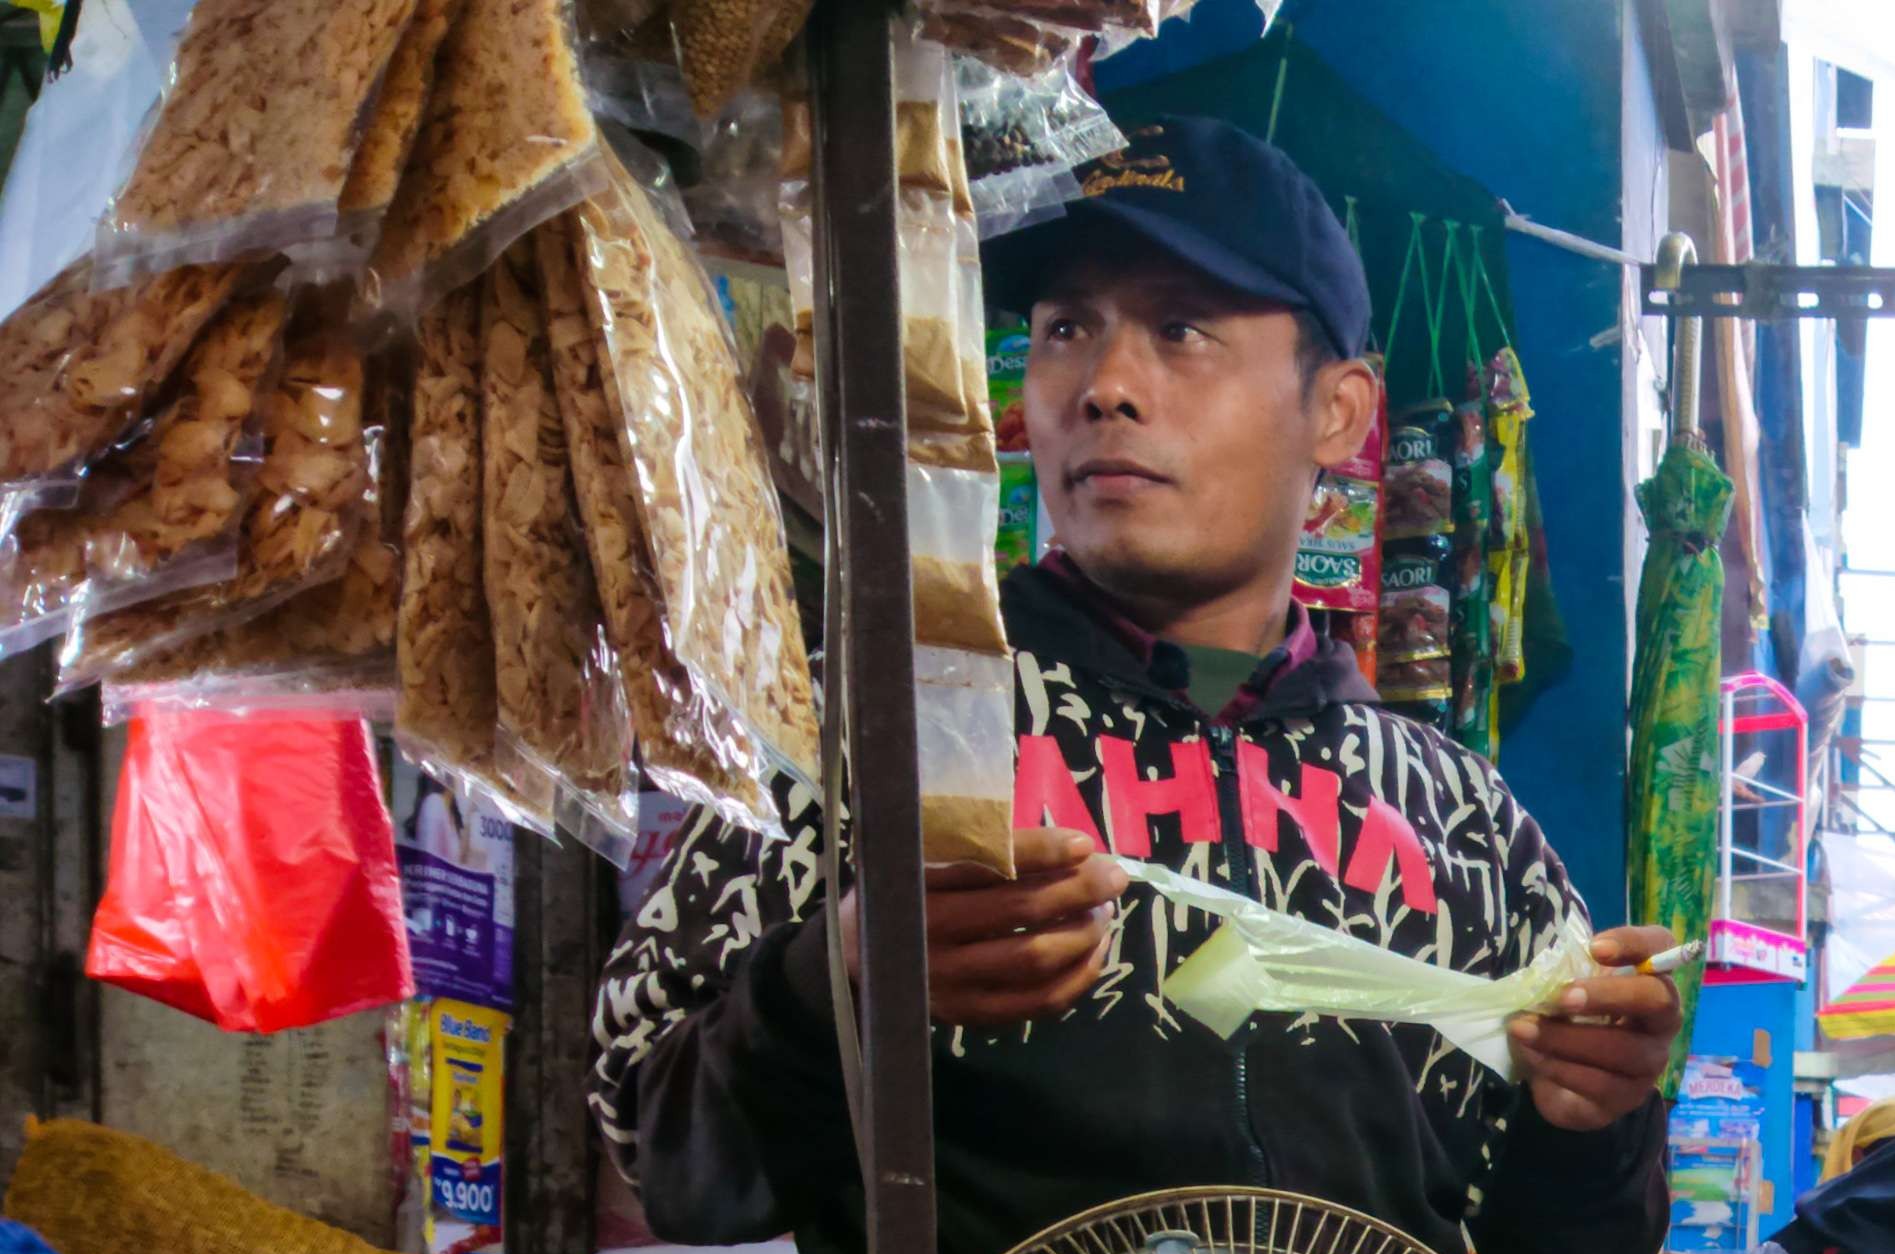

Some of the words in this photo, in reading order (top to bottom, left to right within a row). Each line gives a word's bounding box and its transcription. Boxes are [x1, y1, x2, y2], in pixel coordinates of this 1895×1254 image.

[1388, 438, 1432, 462] AORI
[1296, 552, 1358, 578] SAOR
[441, 1013, 463, 1036] Blue
[441, 1179, 493, 1213] 9.900
